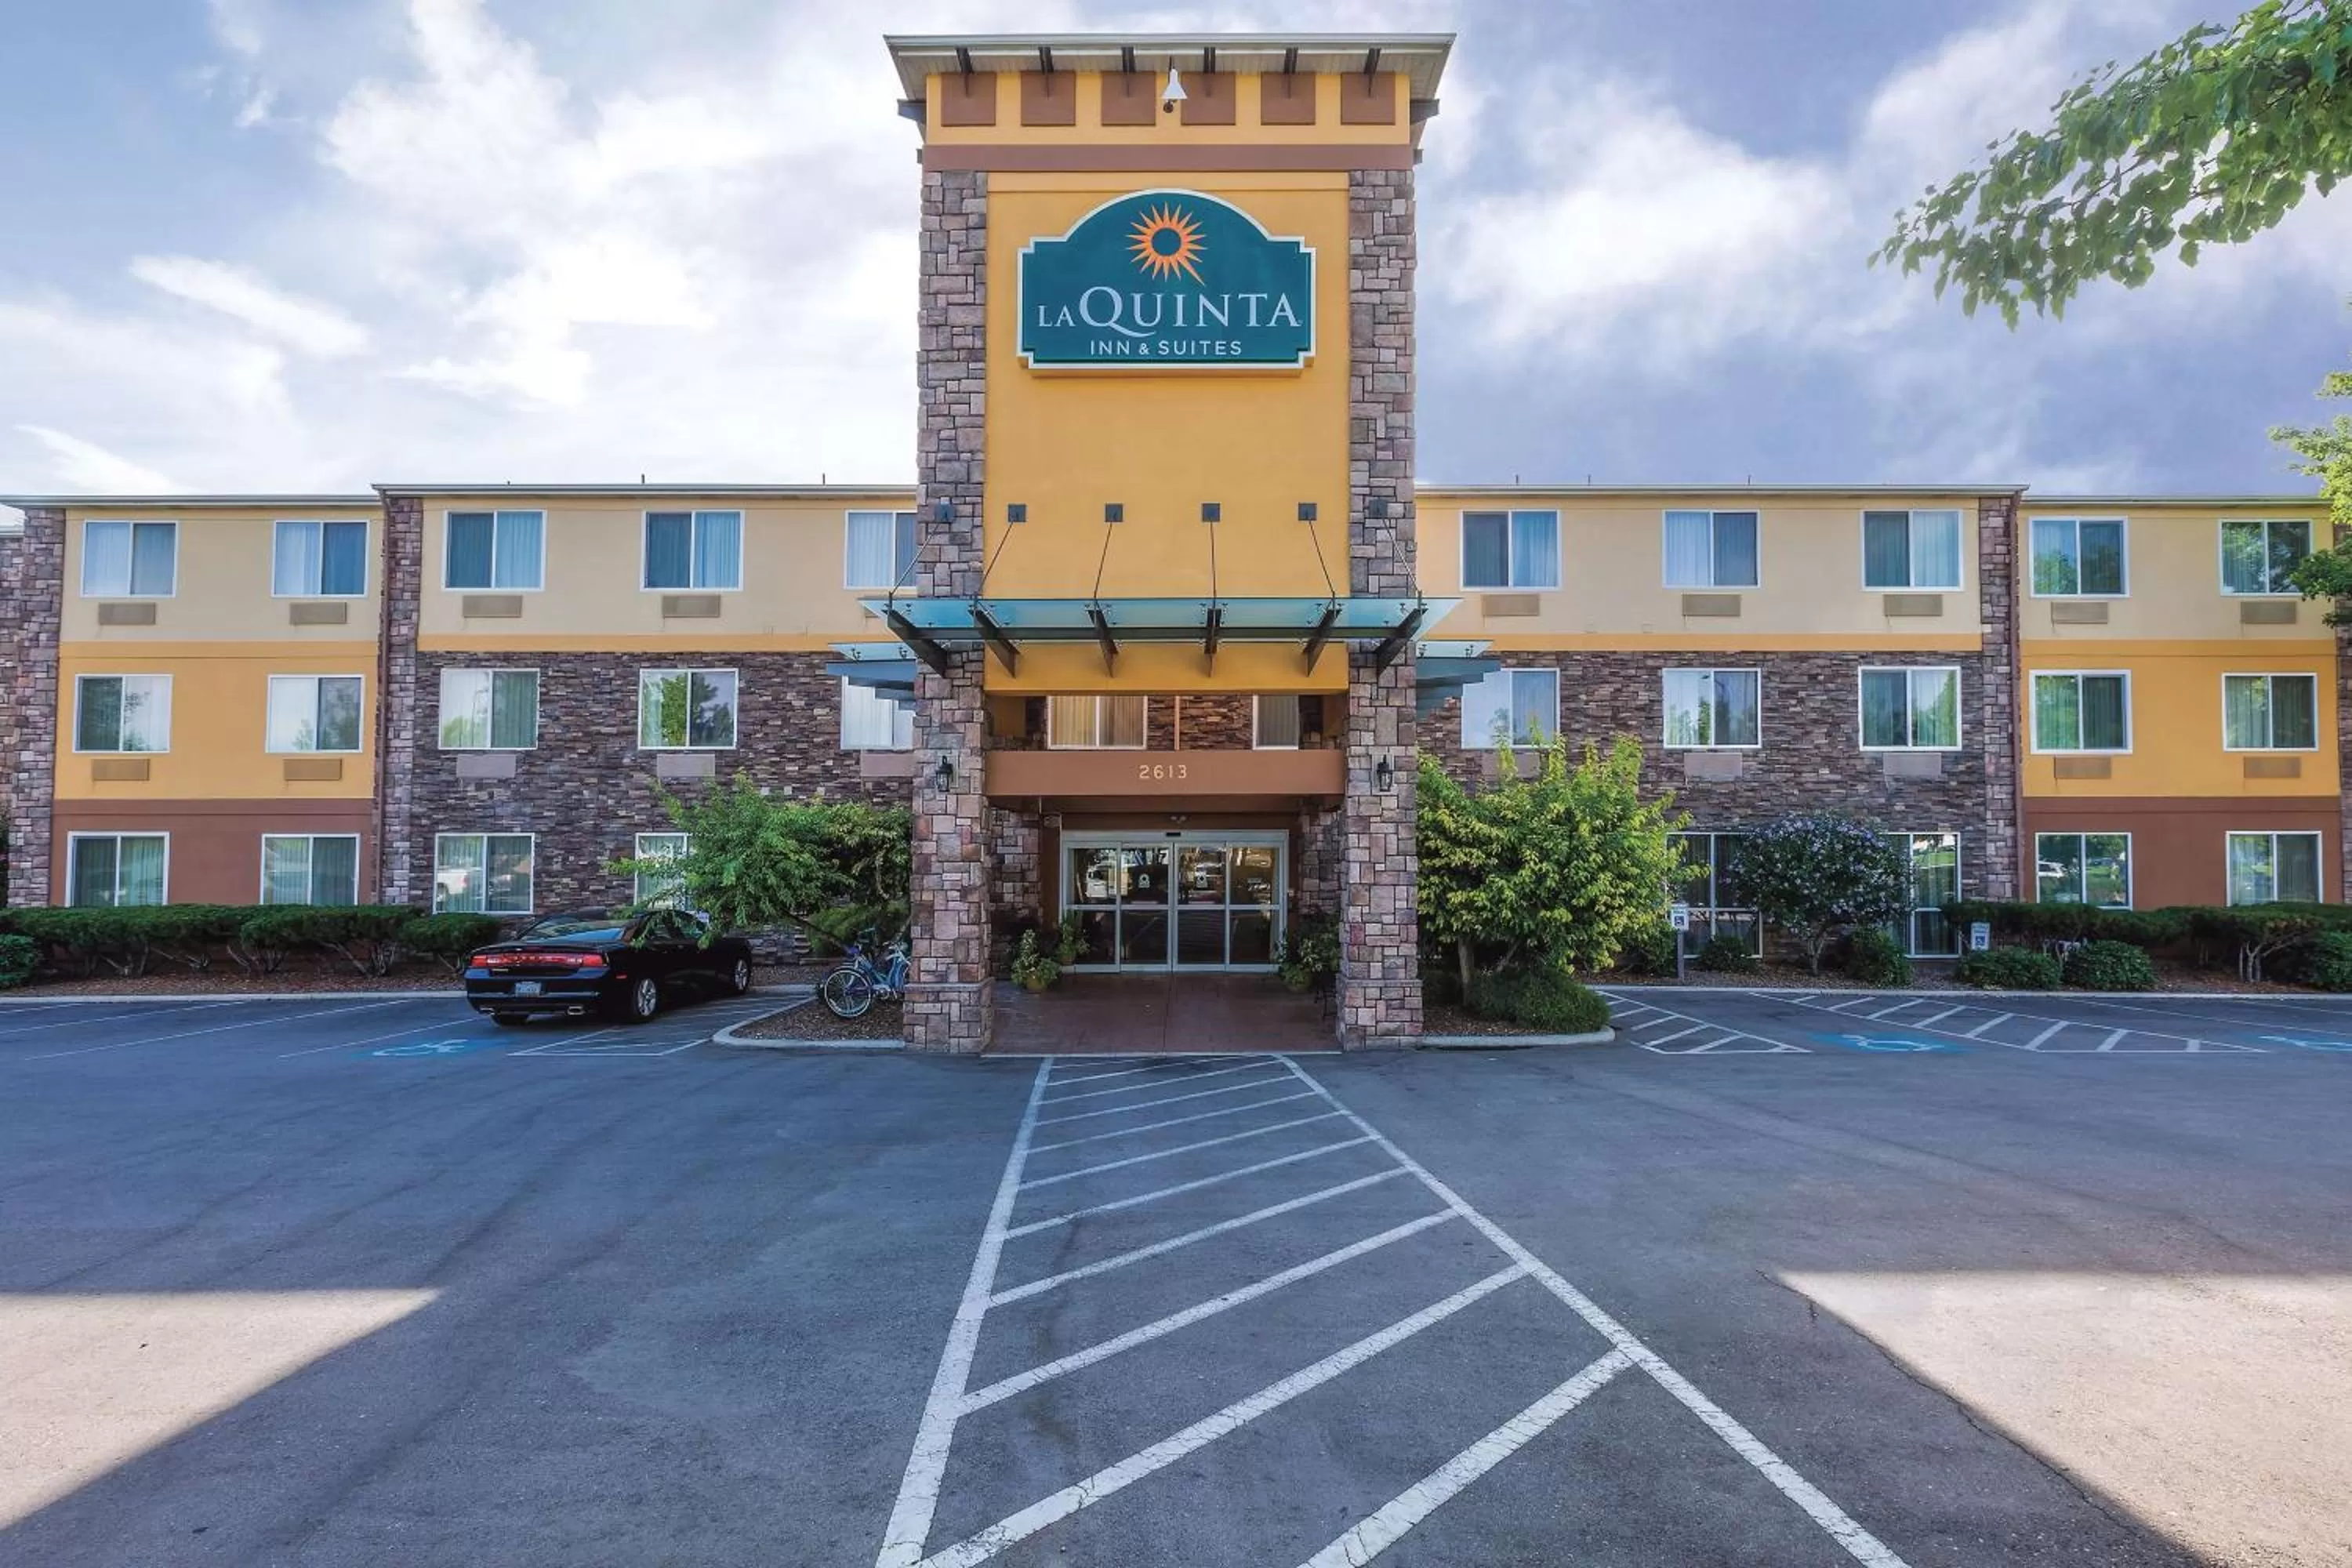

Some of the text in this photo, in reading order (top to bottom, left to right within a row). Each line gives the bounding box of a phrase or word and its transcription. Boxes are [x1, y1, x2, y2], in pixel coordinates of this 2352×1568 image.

[1037, 285, 1301, 338] LA QUINTA
[1090, 339, 1243, 356] INN & SUITES
[1138, 764, 1187, 779] 2613
